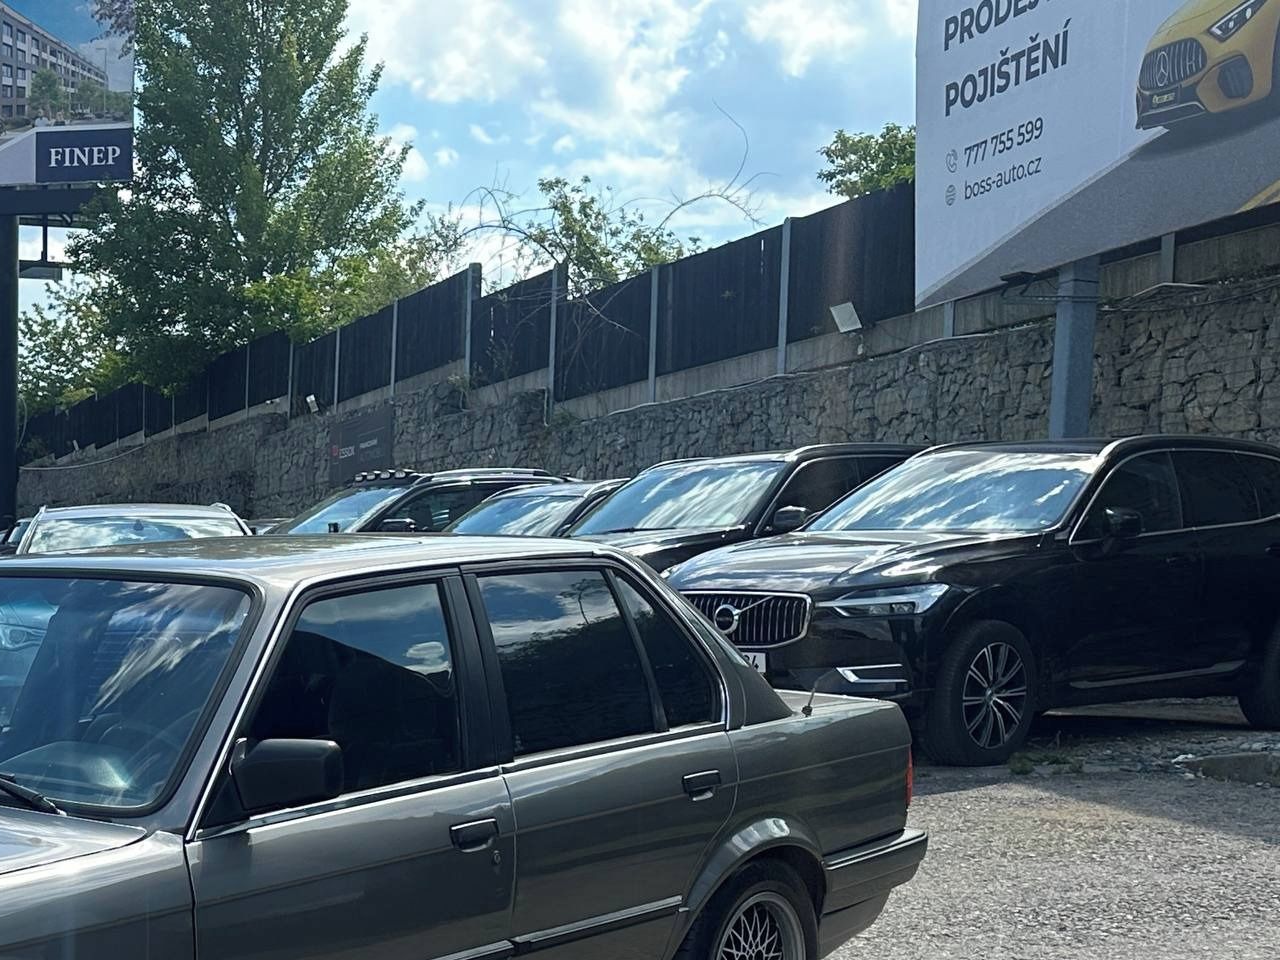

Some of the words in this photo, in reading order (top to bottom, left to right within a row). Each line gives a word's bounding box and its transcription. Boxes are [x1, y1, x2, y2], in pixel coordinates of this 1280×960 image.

[944, 17, 1072, 117] POJIŠTĚNÍ
[49, 146, 121, 167] FINEP
[964, 138, 988, 168] 777
[990, 128, 1014, 157] 755
[1016, 117, 1044, 146] 599
[964, 157, 1042, 200] boss-auto.cz
